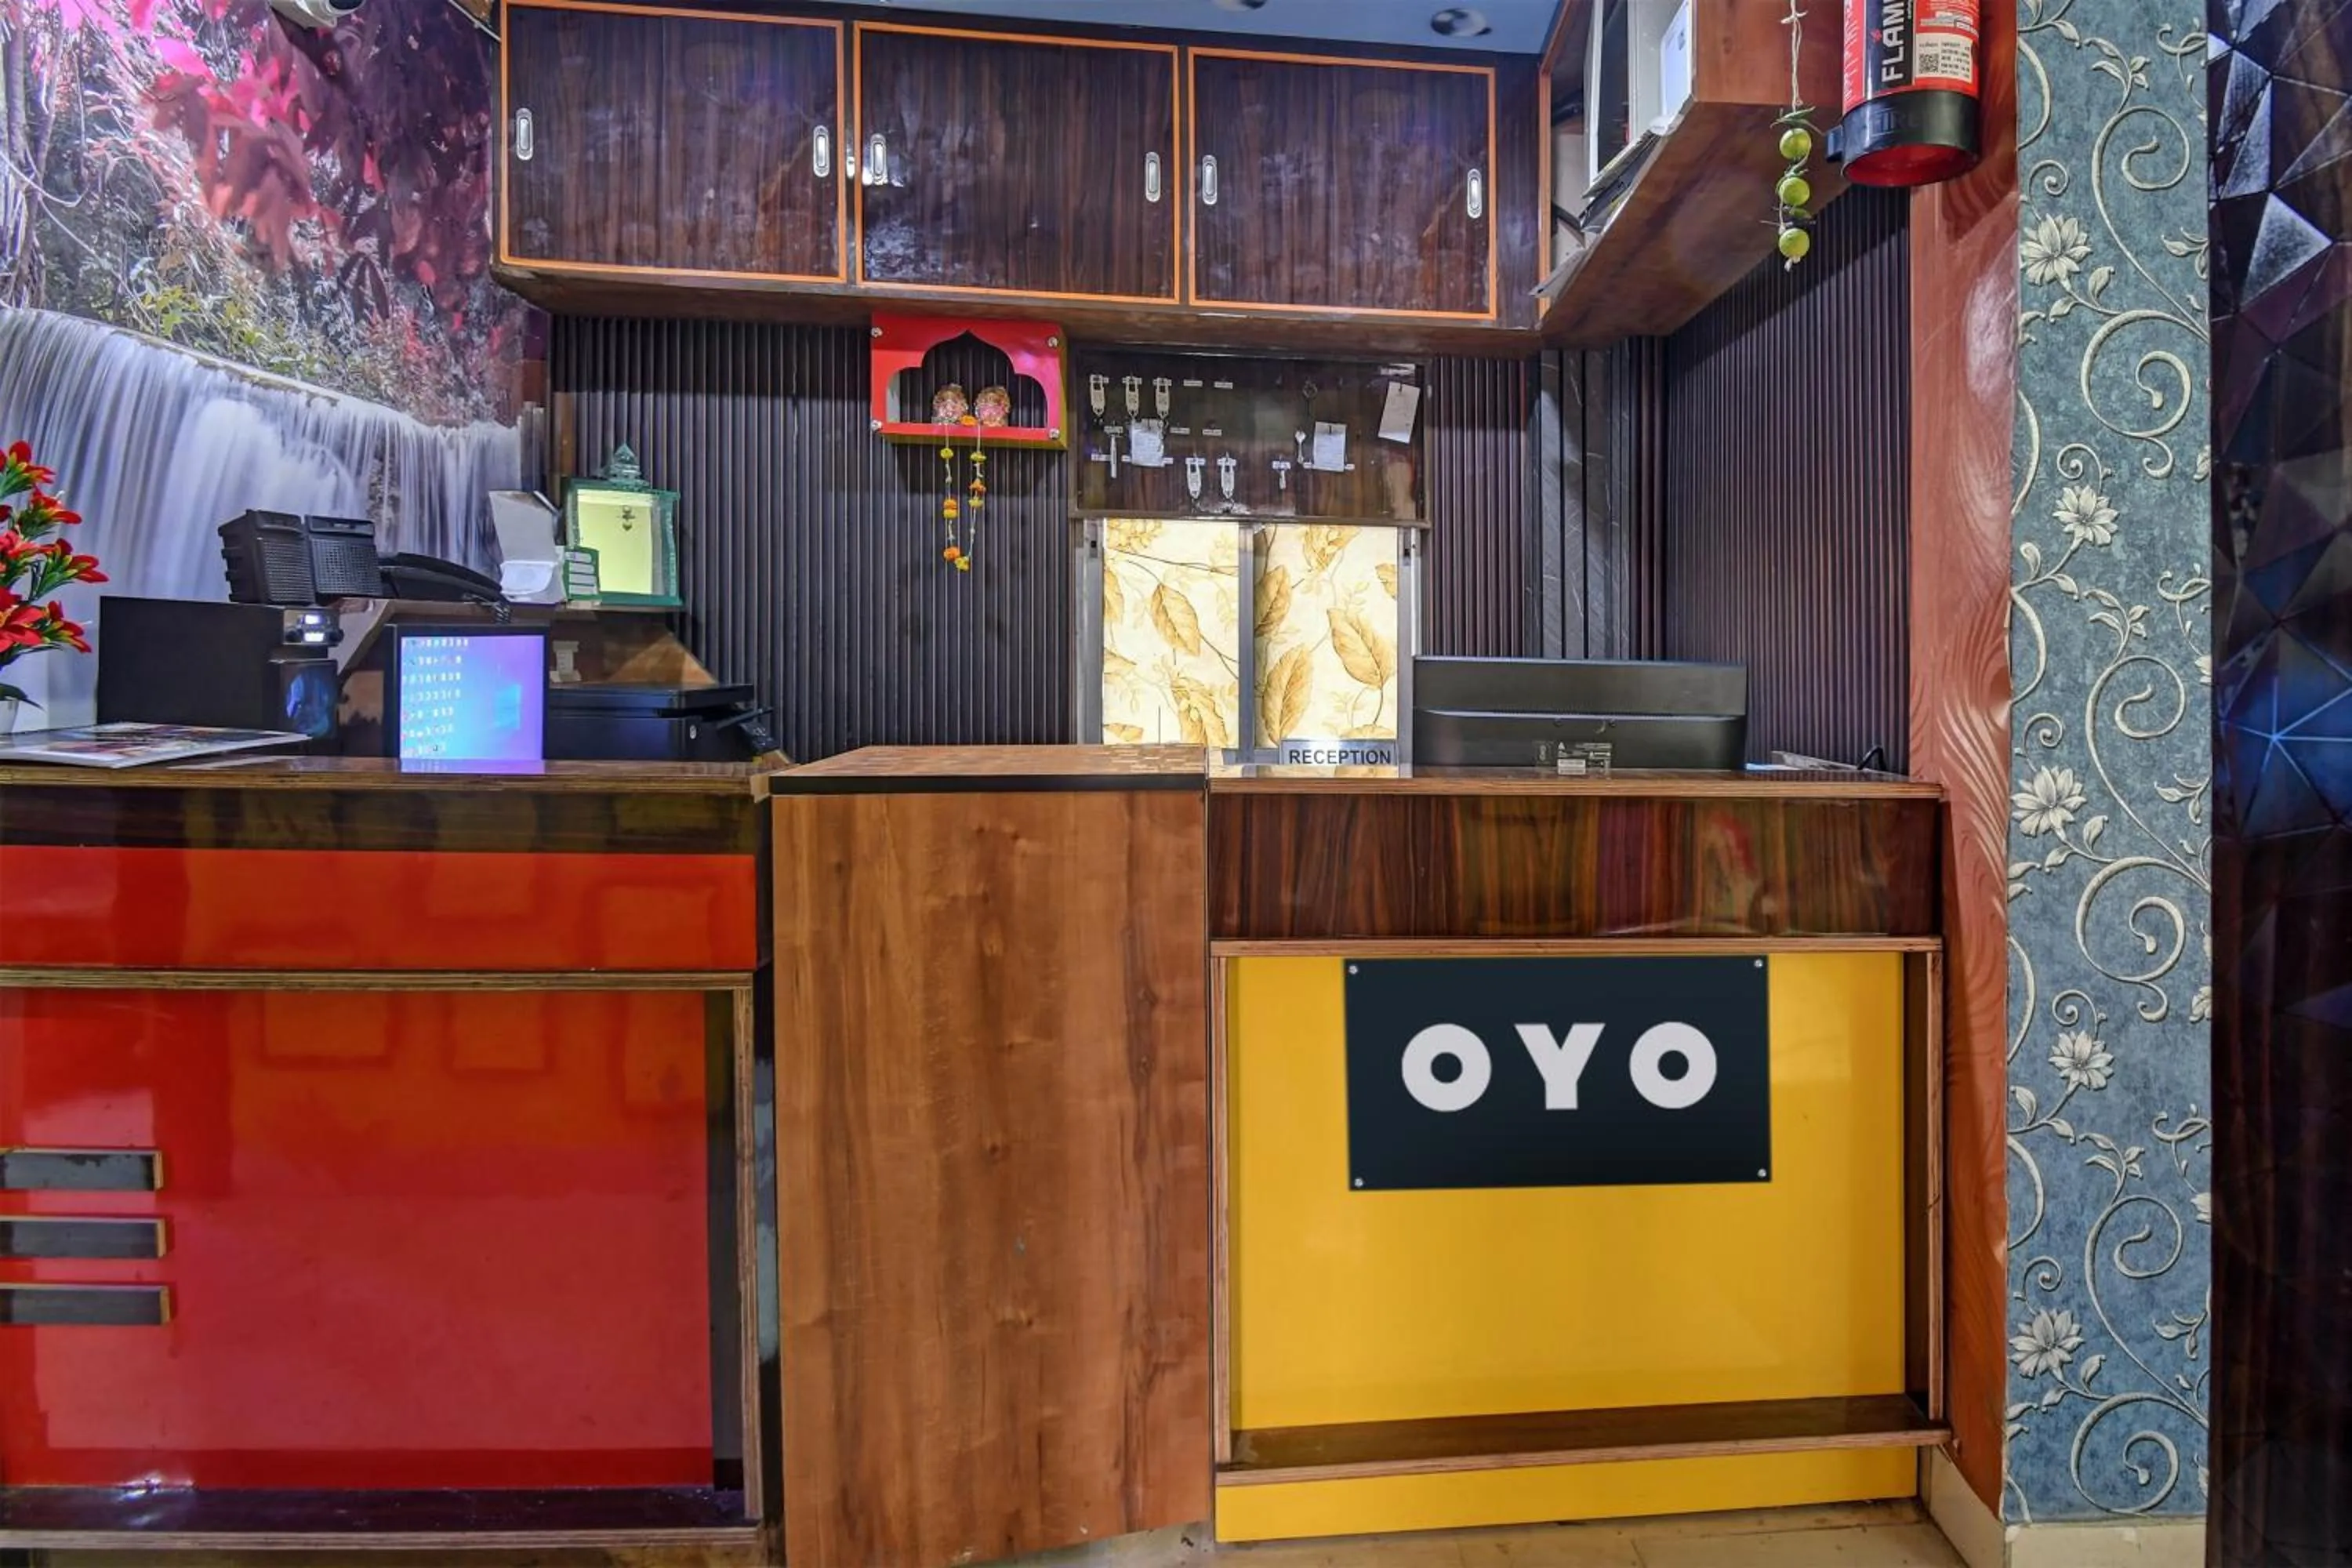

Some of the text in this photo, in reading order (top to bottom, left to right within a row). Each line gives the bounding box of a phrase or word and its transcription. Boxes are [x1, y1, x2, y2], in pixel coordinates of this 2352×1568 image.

[1882, 0, 1904, 82] FLAM
[1288, 750, 1391, 764] RECEPTION
[1402, 1022, 1717, 1112] OYO
